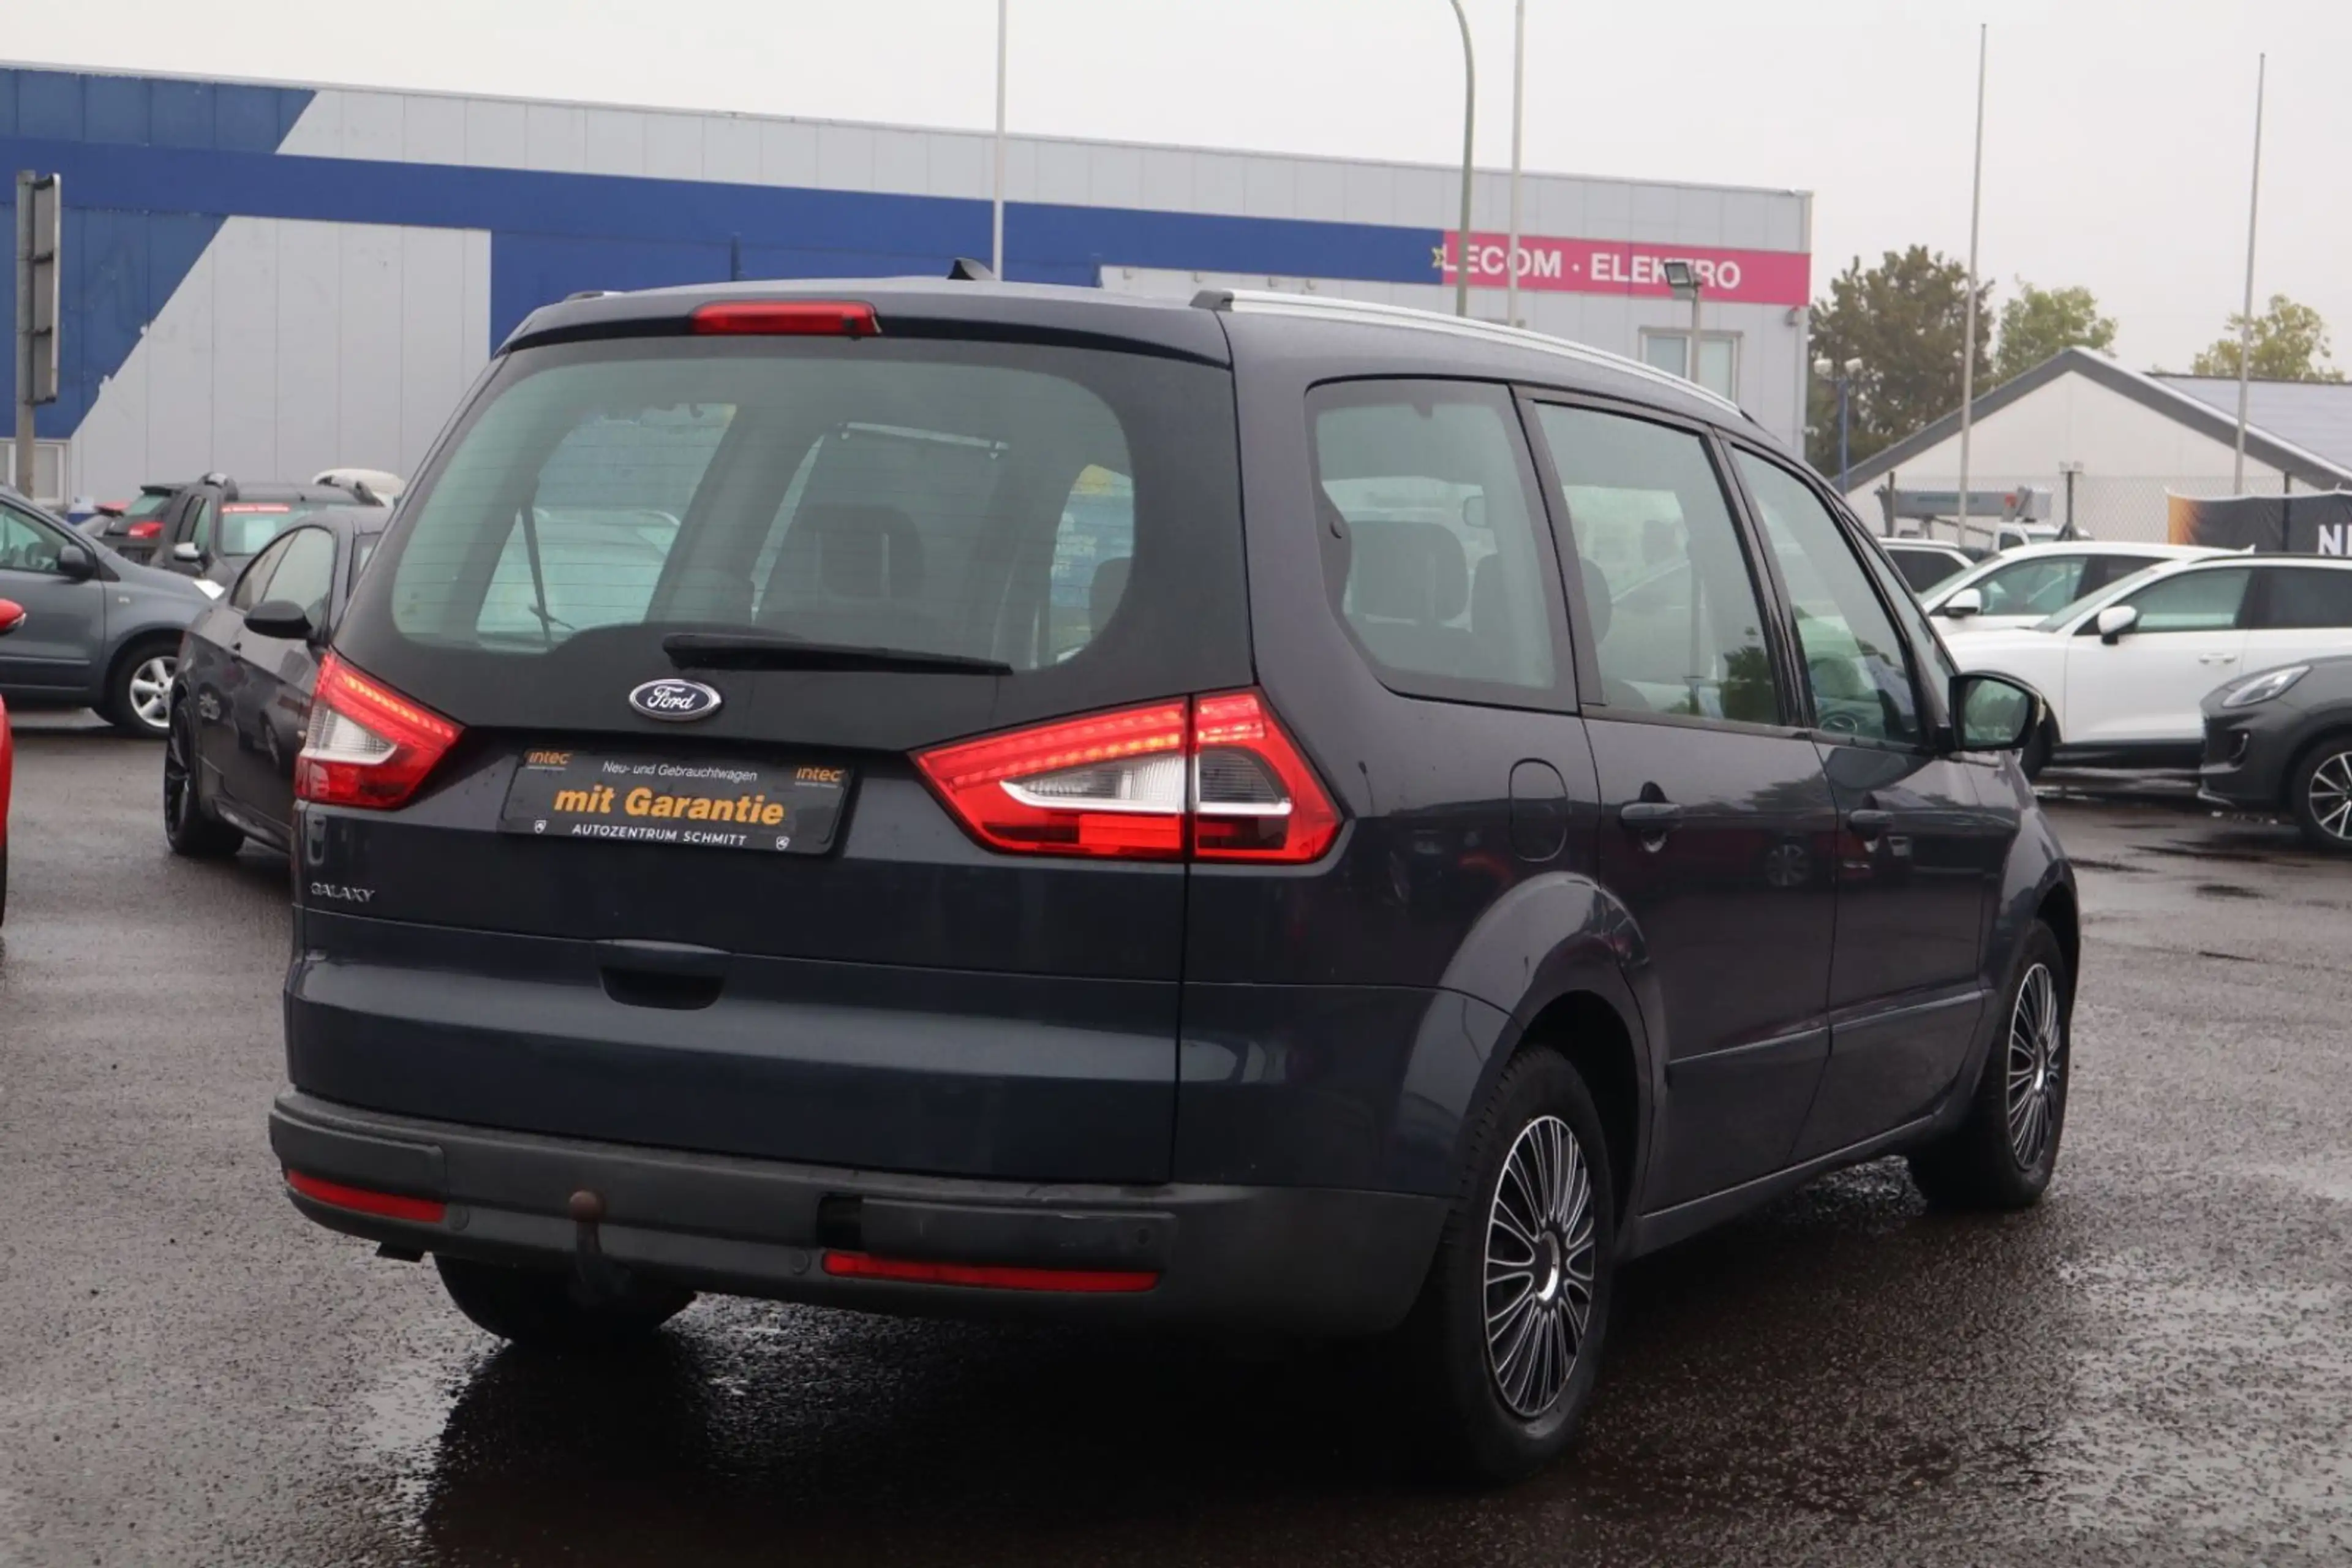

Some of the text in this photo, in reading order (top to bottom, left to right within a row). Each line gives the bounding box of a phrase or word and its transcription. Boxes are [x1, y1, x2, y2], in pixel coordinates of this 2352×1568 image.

[647, 685, 696, 710] Ford
[602, 761, 758, 783] Neu- und Gebrauchtwagen
[554, 785, 785, 826] mit Garantie
[571, 823, 748, 846] AUTOZENTRUM SCHMITT
